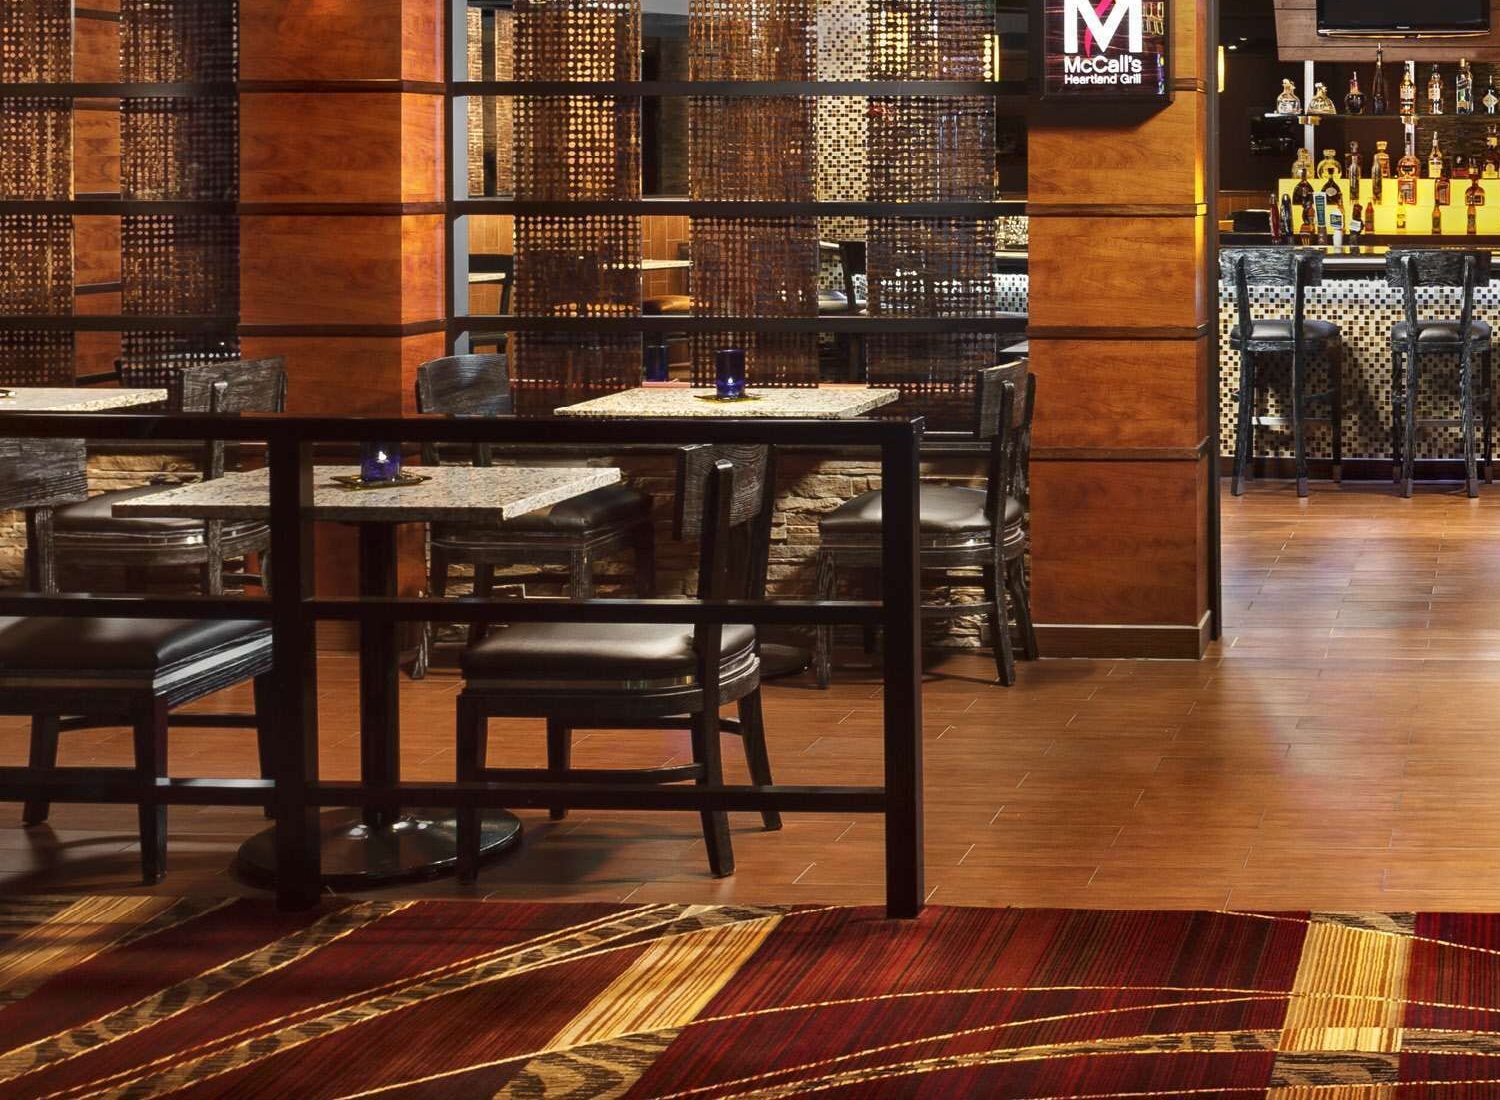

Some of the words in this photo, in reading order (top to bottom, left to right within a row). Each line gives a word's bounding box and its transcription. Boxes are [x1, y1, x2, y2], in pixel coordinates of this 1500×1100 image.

[1064, 54, 1143, 74] McCall's
[1064, 73, 1118, 85] Heartland
[1119, 73, 1142, 85] Grill
